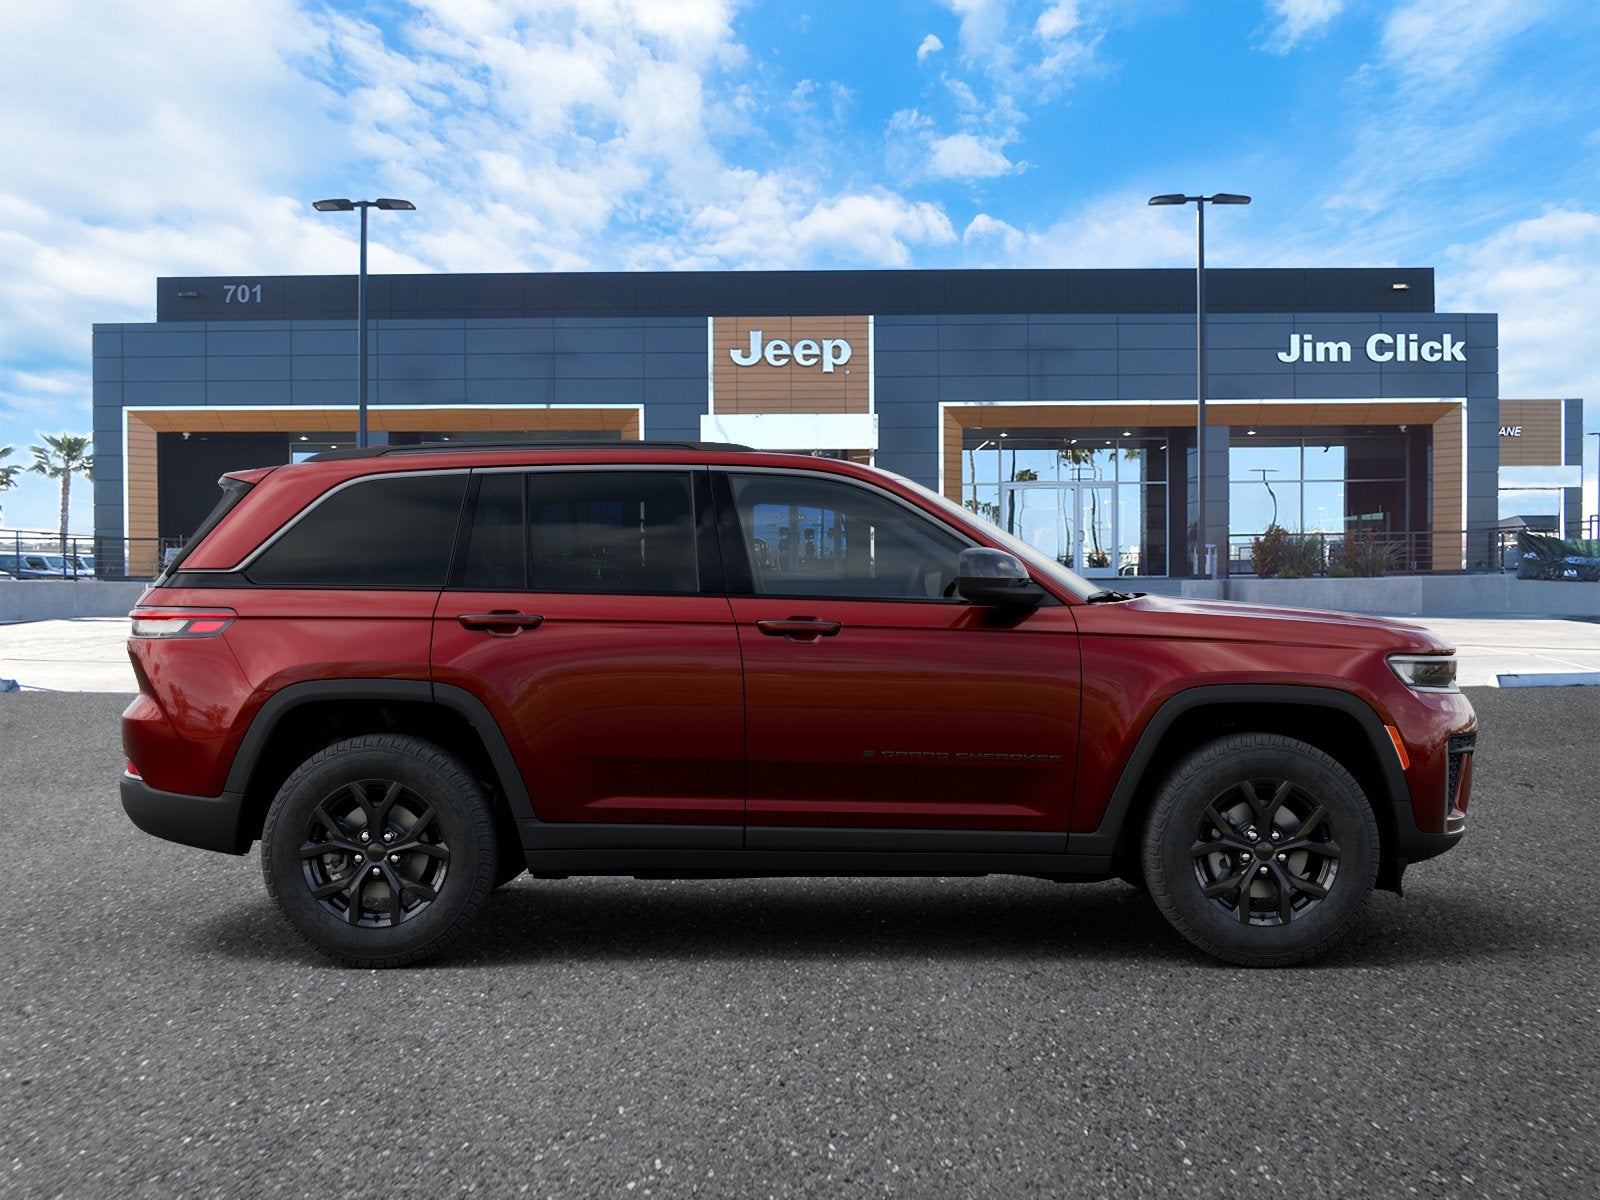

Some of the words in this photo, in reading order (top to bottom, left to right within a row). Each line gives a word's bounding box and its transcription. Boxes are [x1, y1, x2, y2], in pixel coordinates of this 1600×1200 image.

[224, 284, 262, 303] 701
[729, 330, 852, 373] Jeep
[1277, 333, 1351, 363] Jim
[1366, 333, 1467, 362] Click
[881, 750, 949, 759] GRAND
[955, 752, 1062, 761] CHEROKEE
